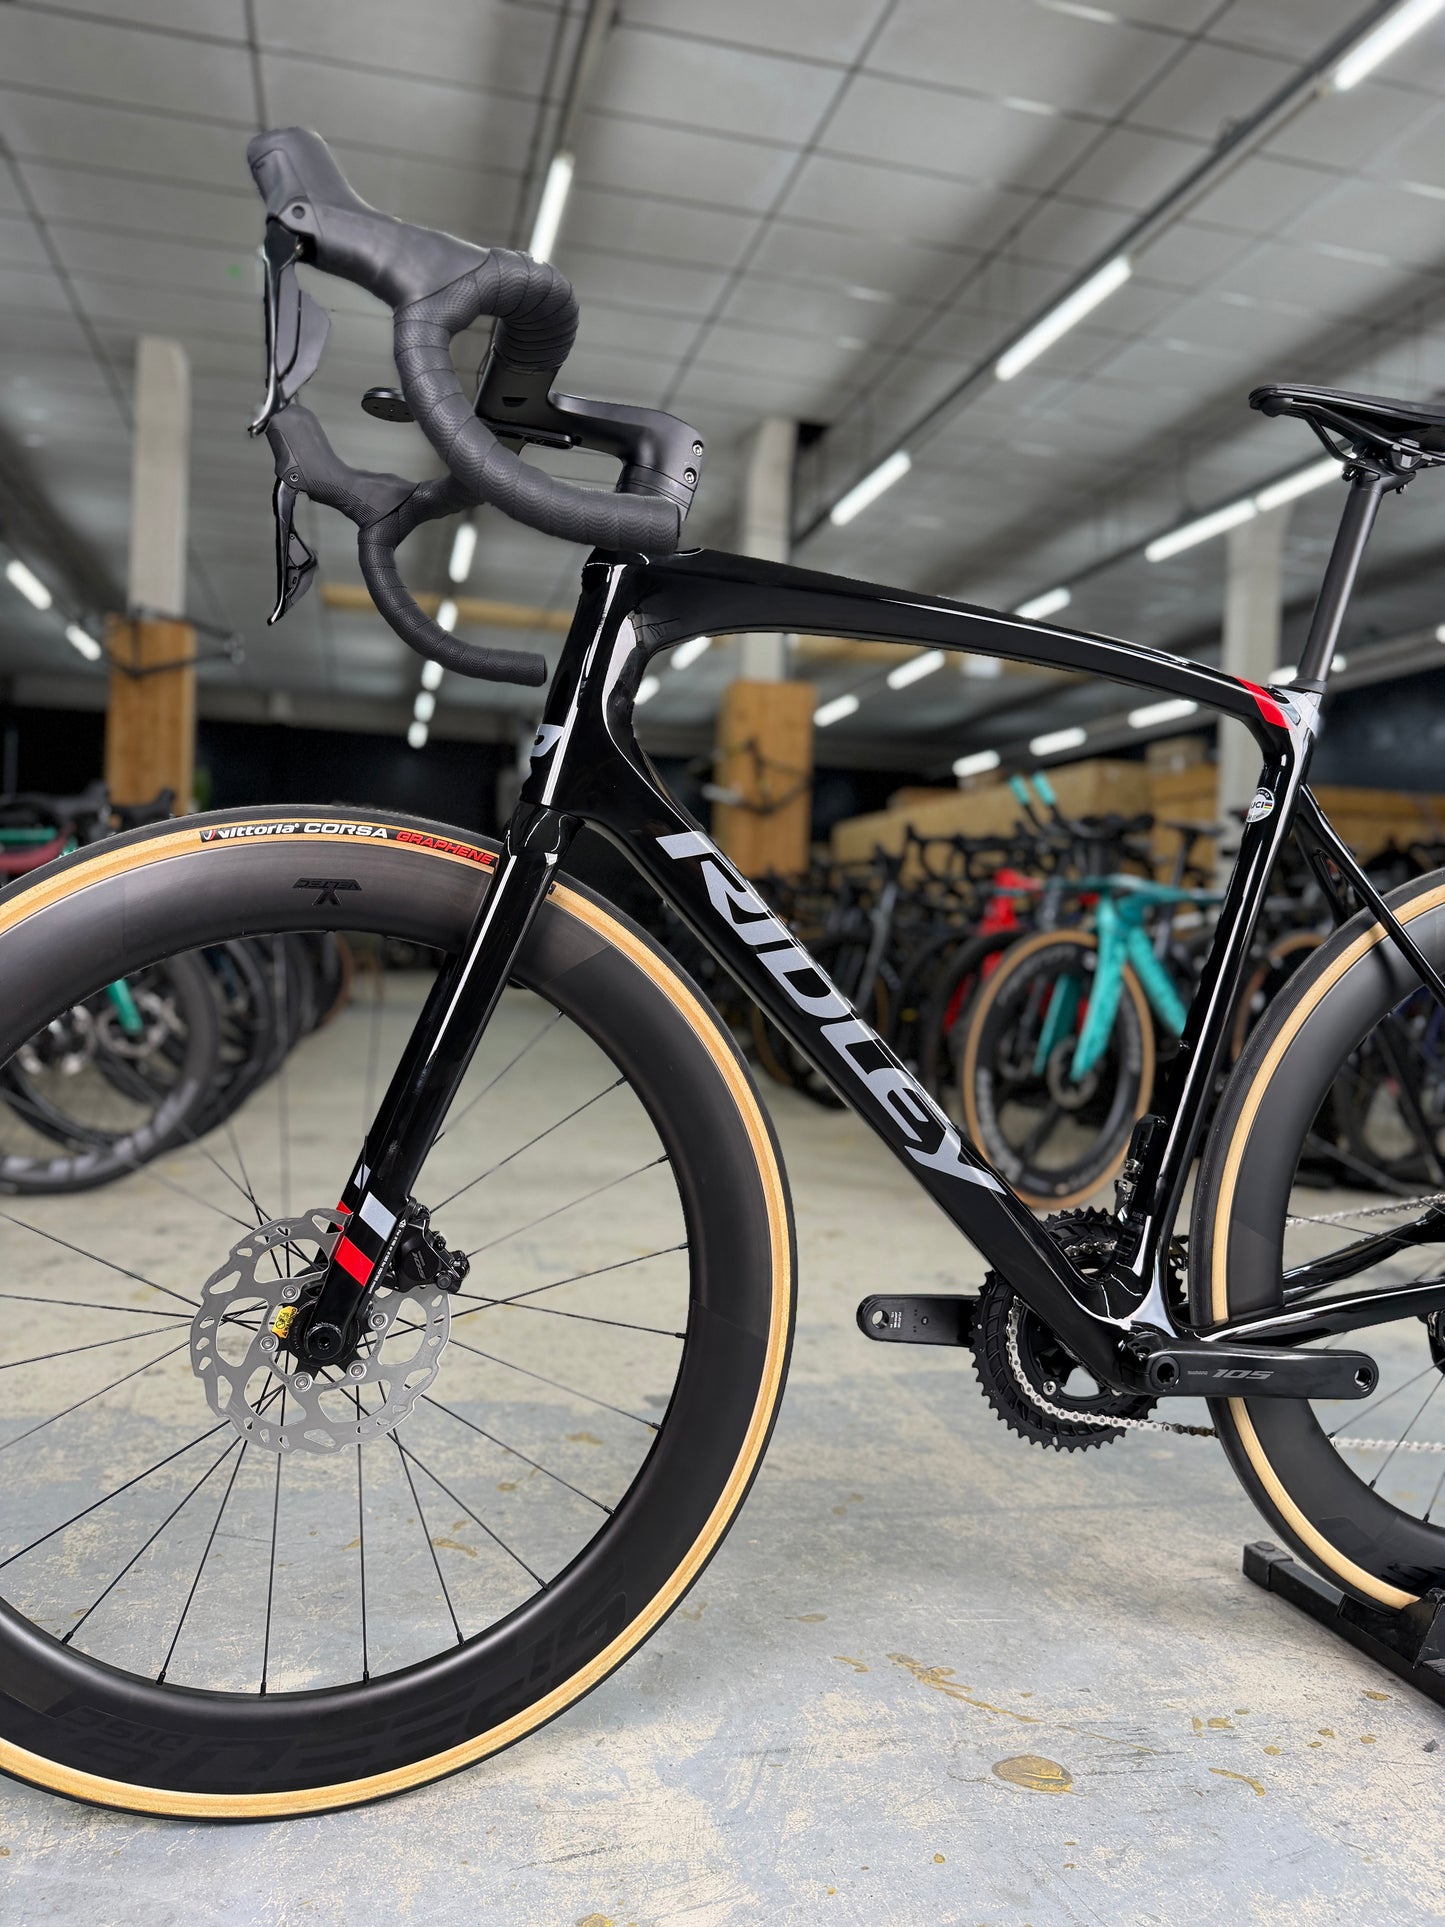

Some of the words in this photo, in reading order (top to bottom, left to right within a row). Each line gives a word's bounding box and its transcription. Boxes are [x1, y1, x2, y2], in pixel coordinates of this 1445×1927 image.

[303, 822, 388, 839] CORSA
[395, 831, 494, 865] GRAPHENE
[294, 878, 361, 891] VELTEC
[655, 830, 1008, 1196] RIDLEY
[411, 1252, 427, 1280] 105
[1212, 1368, 1274, 1380] 105
